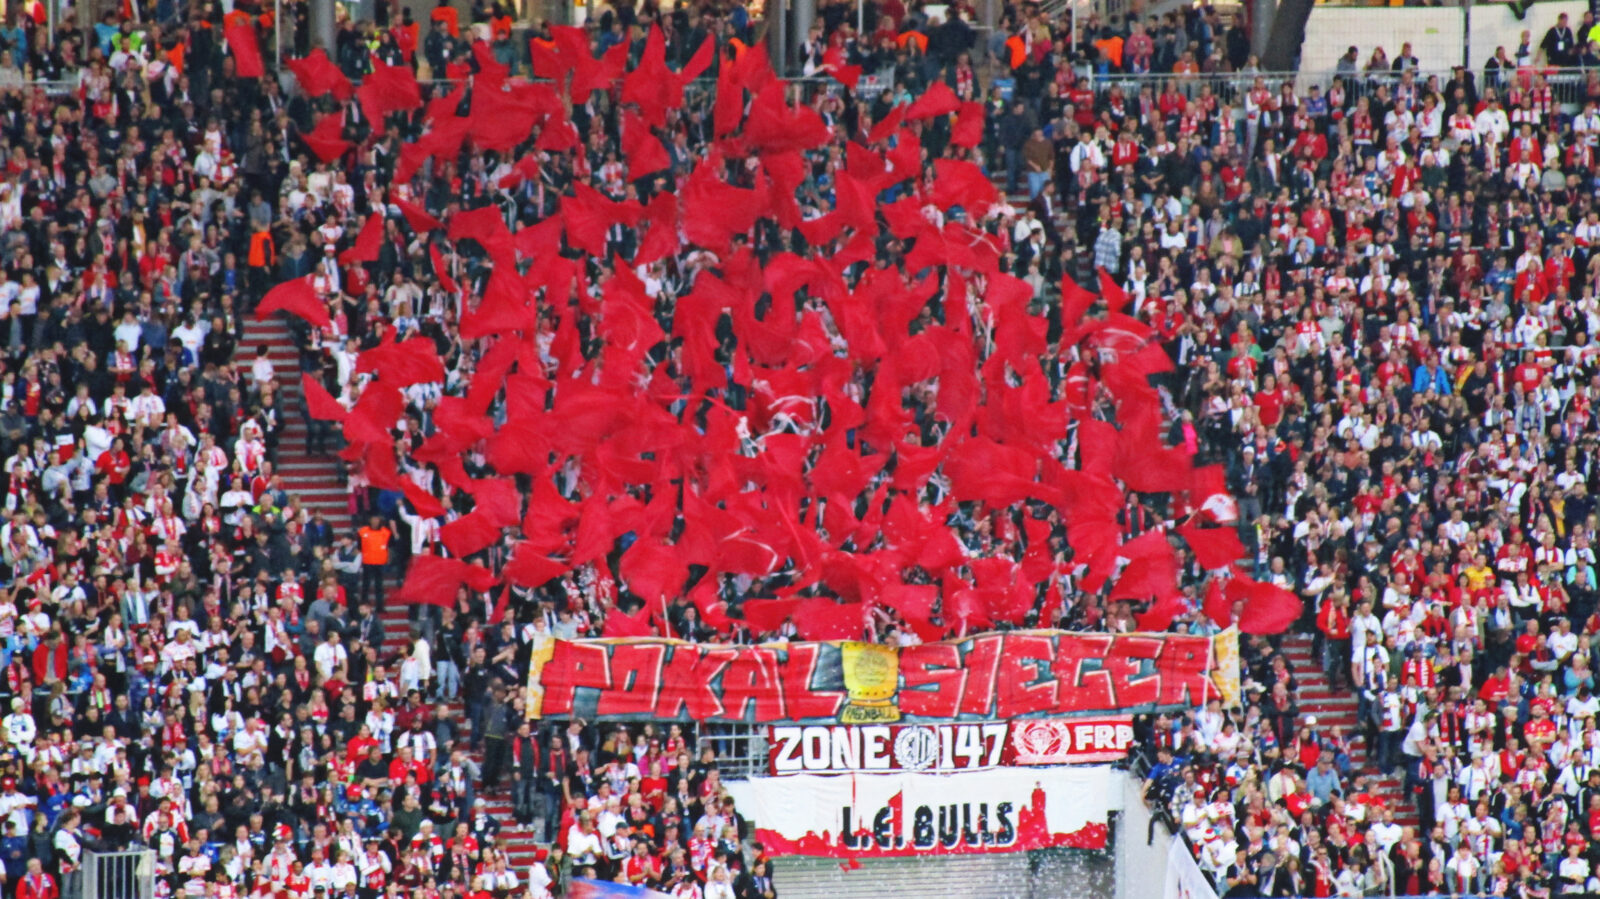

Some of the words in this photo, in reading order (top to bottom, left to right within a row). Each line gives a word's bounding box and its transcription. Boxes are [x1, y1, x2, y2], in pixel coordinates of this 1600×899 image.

[541, 638, 847, 722] POKAL
[899, 633, 1224, 719] SIEGER
[774, 725, 891, 771] ZONE
[939, 723, 1009, 769] 147
[1075, 724, 1134, 750] FRP
[913, 801, 1014, 849] BULLS
